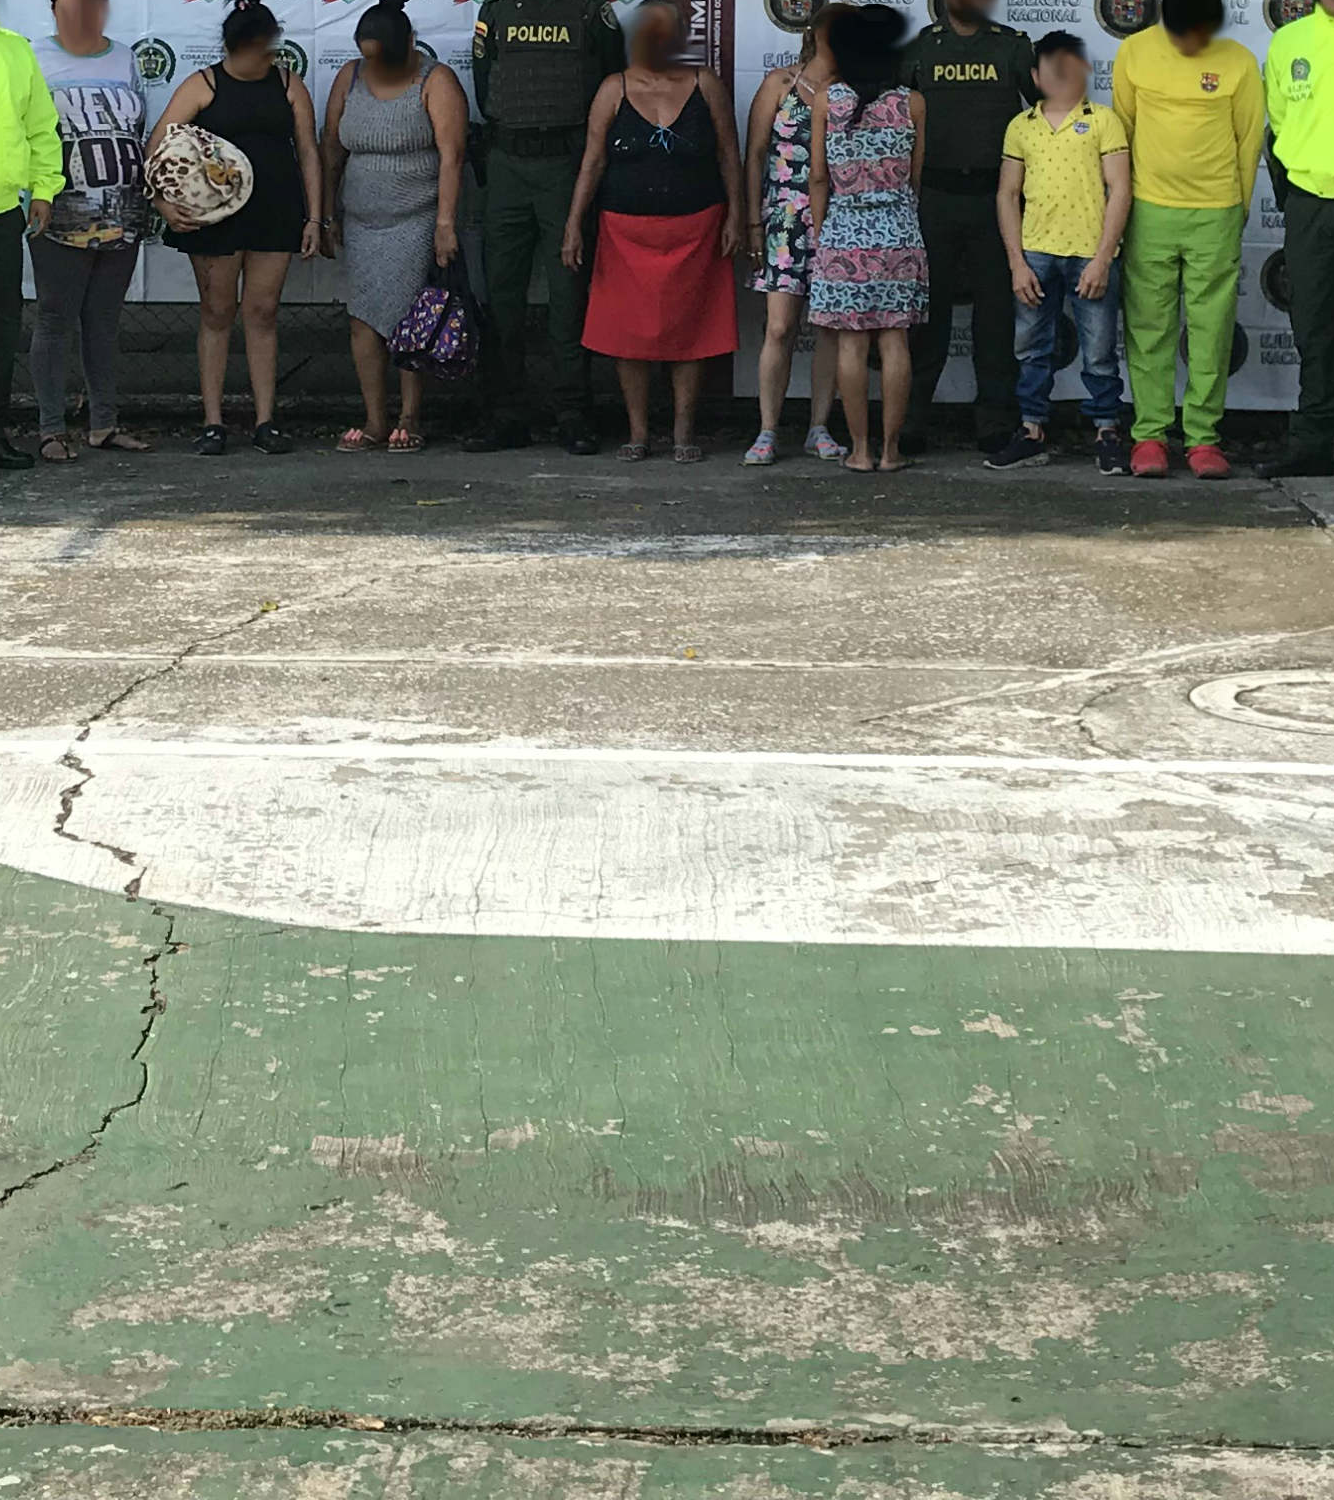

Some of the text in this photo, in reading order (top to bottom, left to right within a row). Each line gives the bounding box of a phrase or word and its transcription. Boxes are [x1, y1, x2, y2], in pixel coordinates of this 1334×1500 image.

[1007, 7, 1082, 24] NACIONAL
[506, 26, 570, 43] POLICIA
[934, 63, 999, 81] POLICIA
[52, 87, 142, 134] NEW
